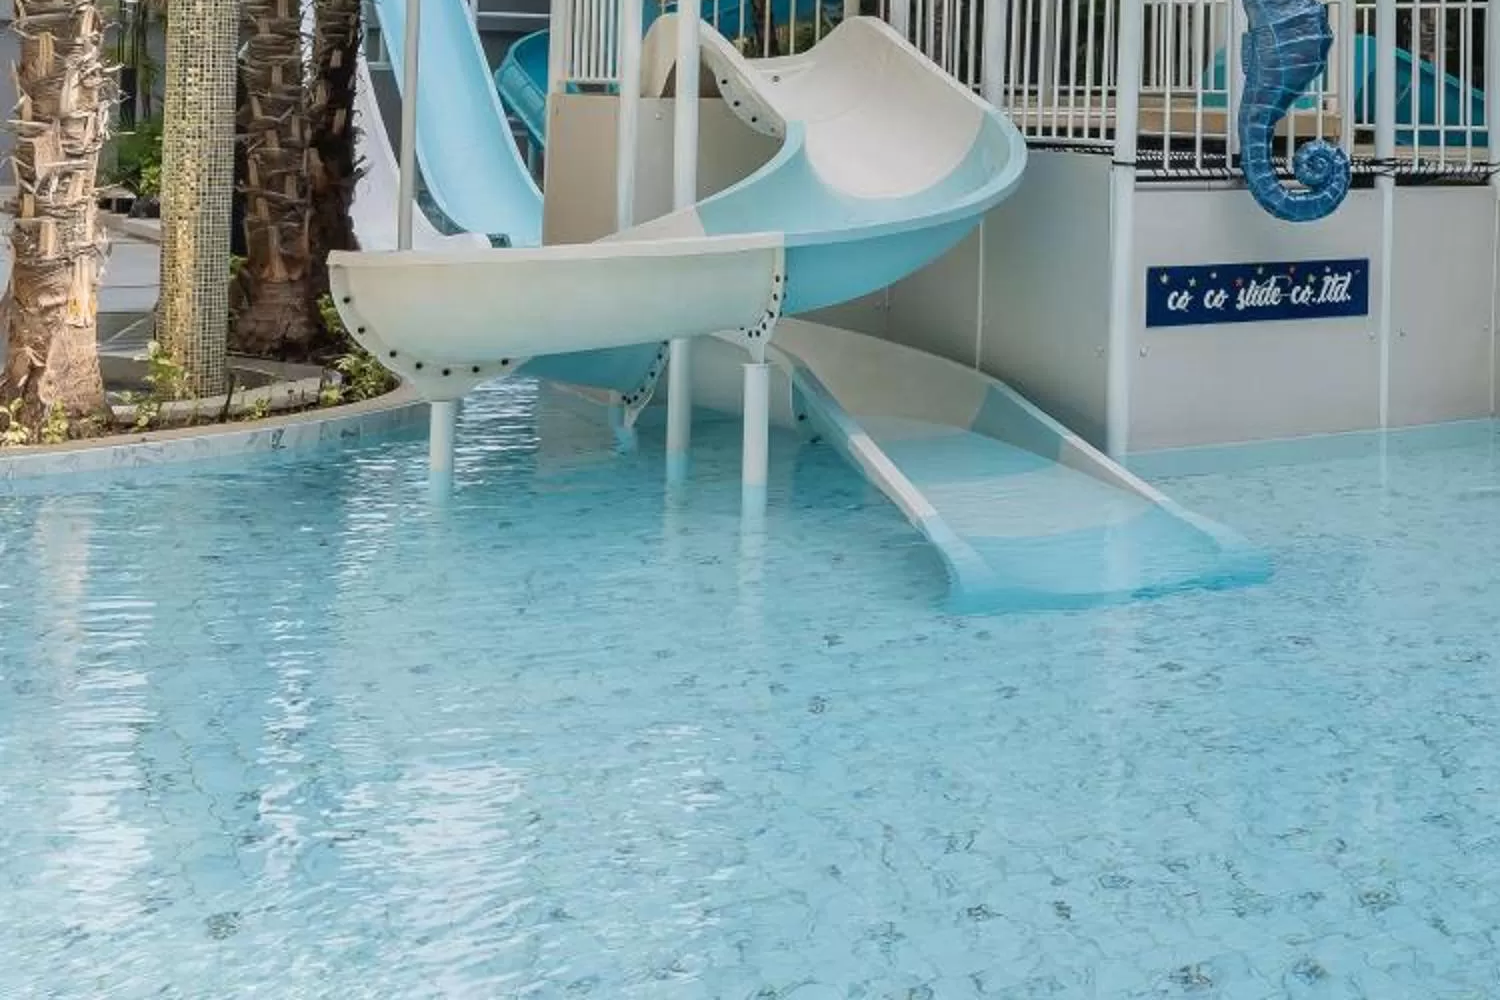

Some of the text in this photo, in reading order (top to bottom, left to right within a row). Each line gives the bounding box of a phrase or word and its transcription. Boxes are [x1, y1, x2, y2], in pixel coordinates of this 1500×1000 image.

[1167, 289, 1192, 312] co
[1203, 288, 1229, 310] co
[1236, 275, 1282, 311] slide
